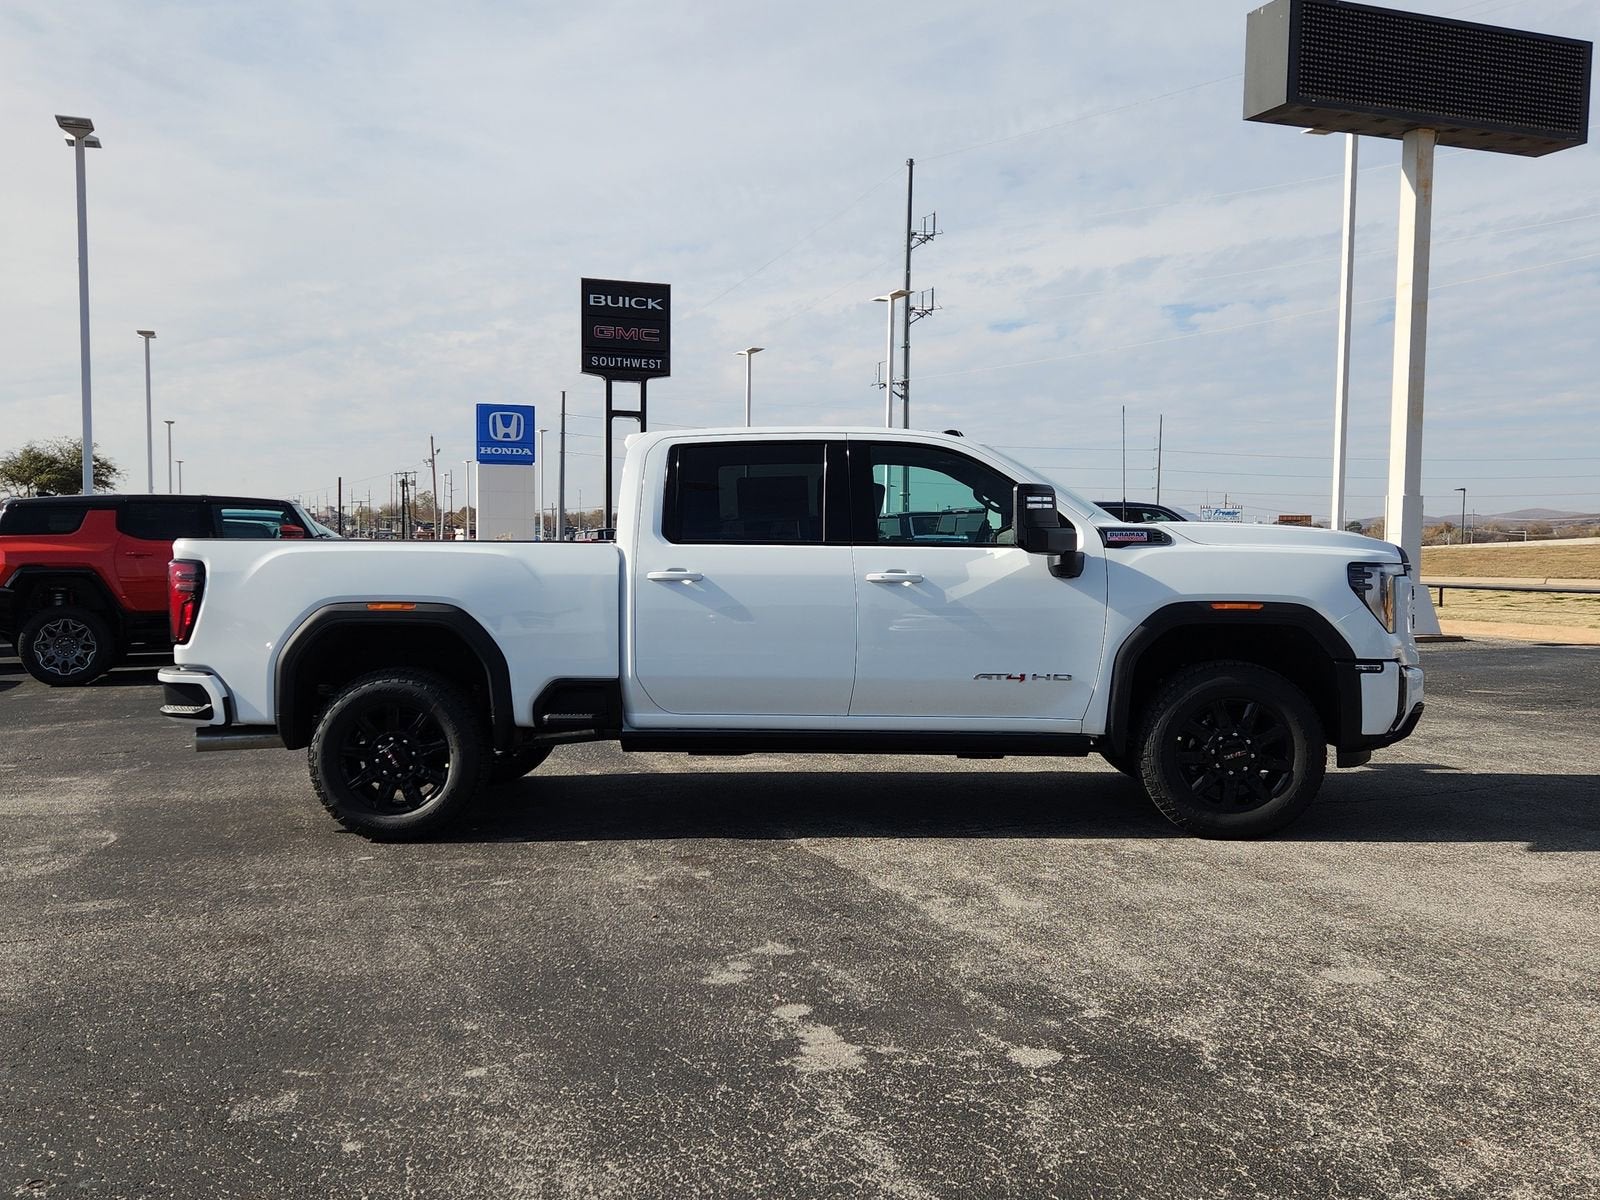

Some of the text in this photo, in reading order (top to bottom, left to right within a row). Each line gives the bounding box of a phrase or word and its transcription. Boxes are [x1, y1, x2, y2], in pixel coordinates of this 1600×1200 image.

[589, 294, 664, 310] BUICK
[593, 325, 660, 342] GMC
[591, 356, 662, 369] SOUTHWEST
[479, 446, 533, 456] HONDA
[973, 673, 1072, 683] AT4 HD
